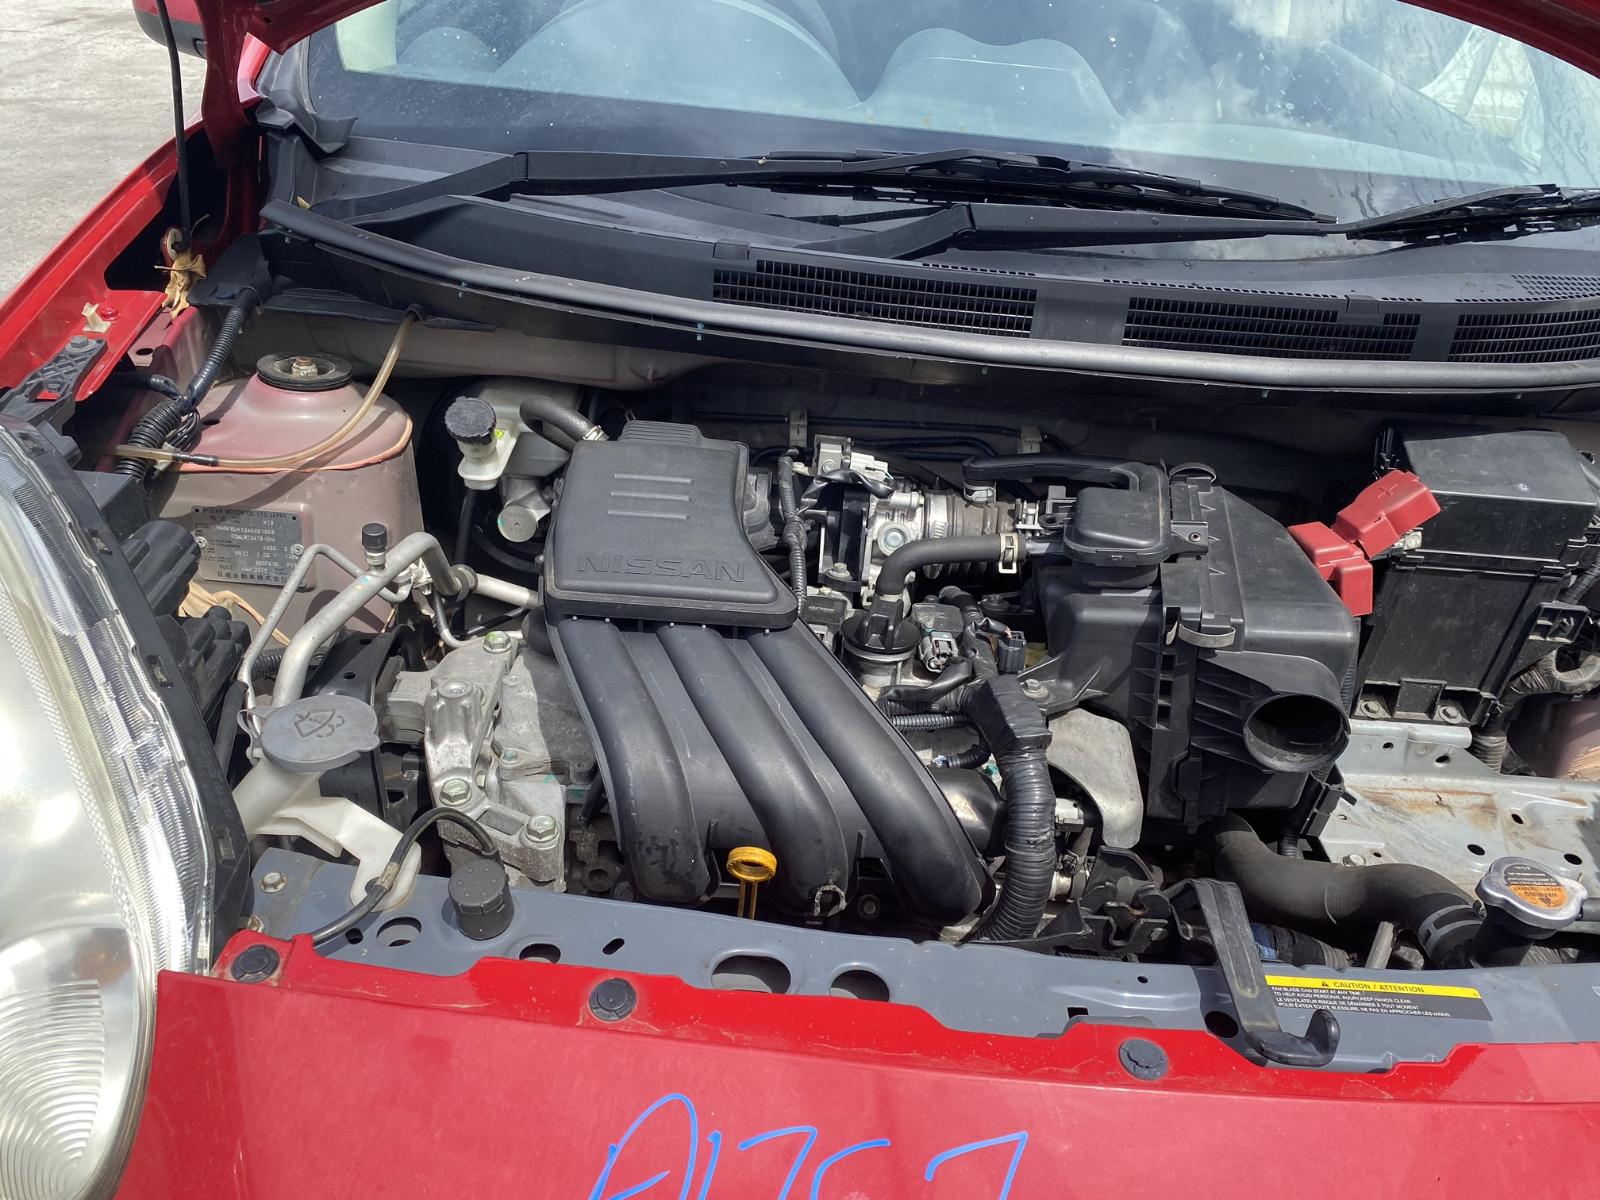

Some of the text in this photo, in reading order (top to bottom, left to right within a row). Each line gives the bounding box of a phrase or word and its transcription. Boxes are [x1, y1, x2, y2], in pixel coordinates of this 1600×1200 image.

[578, 551, 747, 583] NISSAN
[1333, 981, 1371, 989] CAUTION
[1379, 984, 1424, 993] ATTENTION
